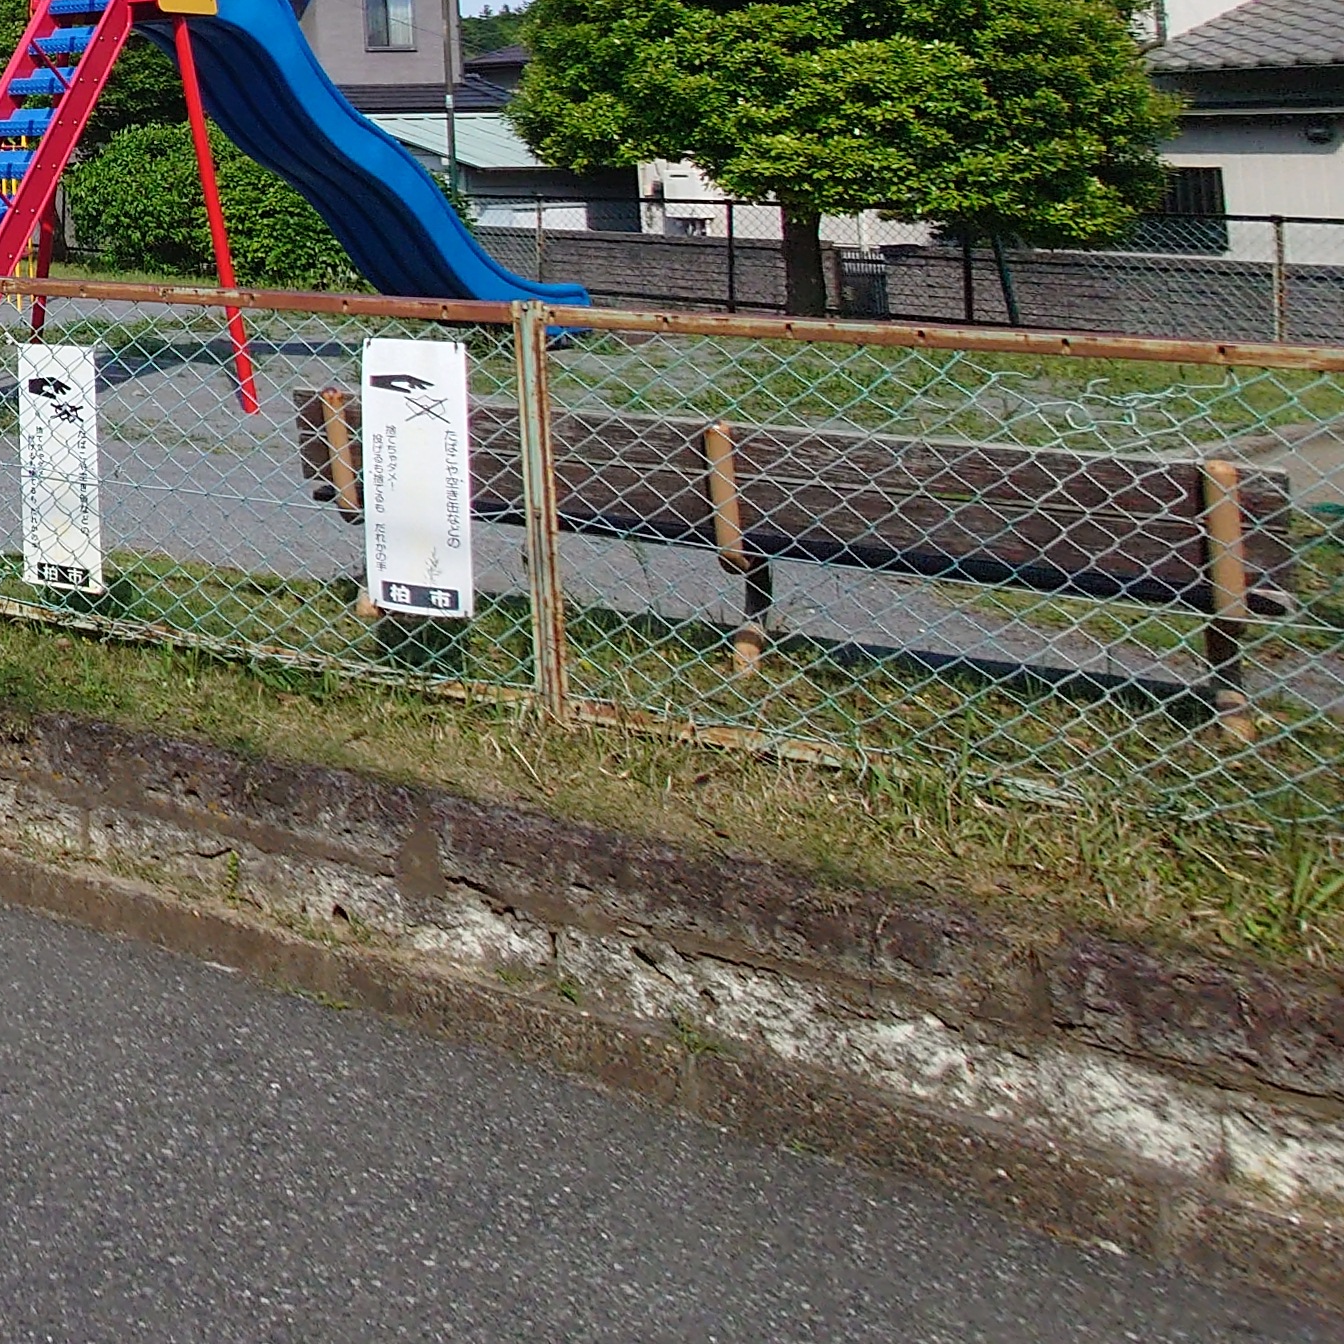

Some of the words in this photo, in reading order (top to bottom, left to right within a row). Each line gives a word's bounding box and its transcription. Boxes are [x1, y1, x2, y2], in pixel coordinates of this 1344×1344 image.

[444, 430, 461, 549] たばこや空き缶などの
[375, 523, 387, 572] だれかの手
[43, 563, 84, 585] 柏市
[389, 584, 452, 608] 柏市
